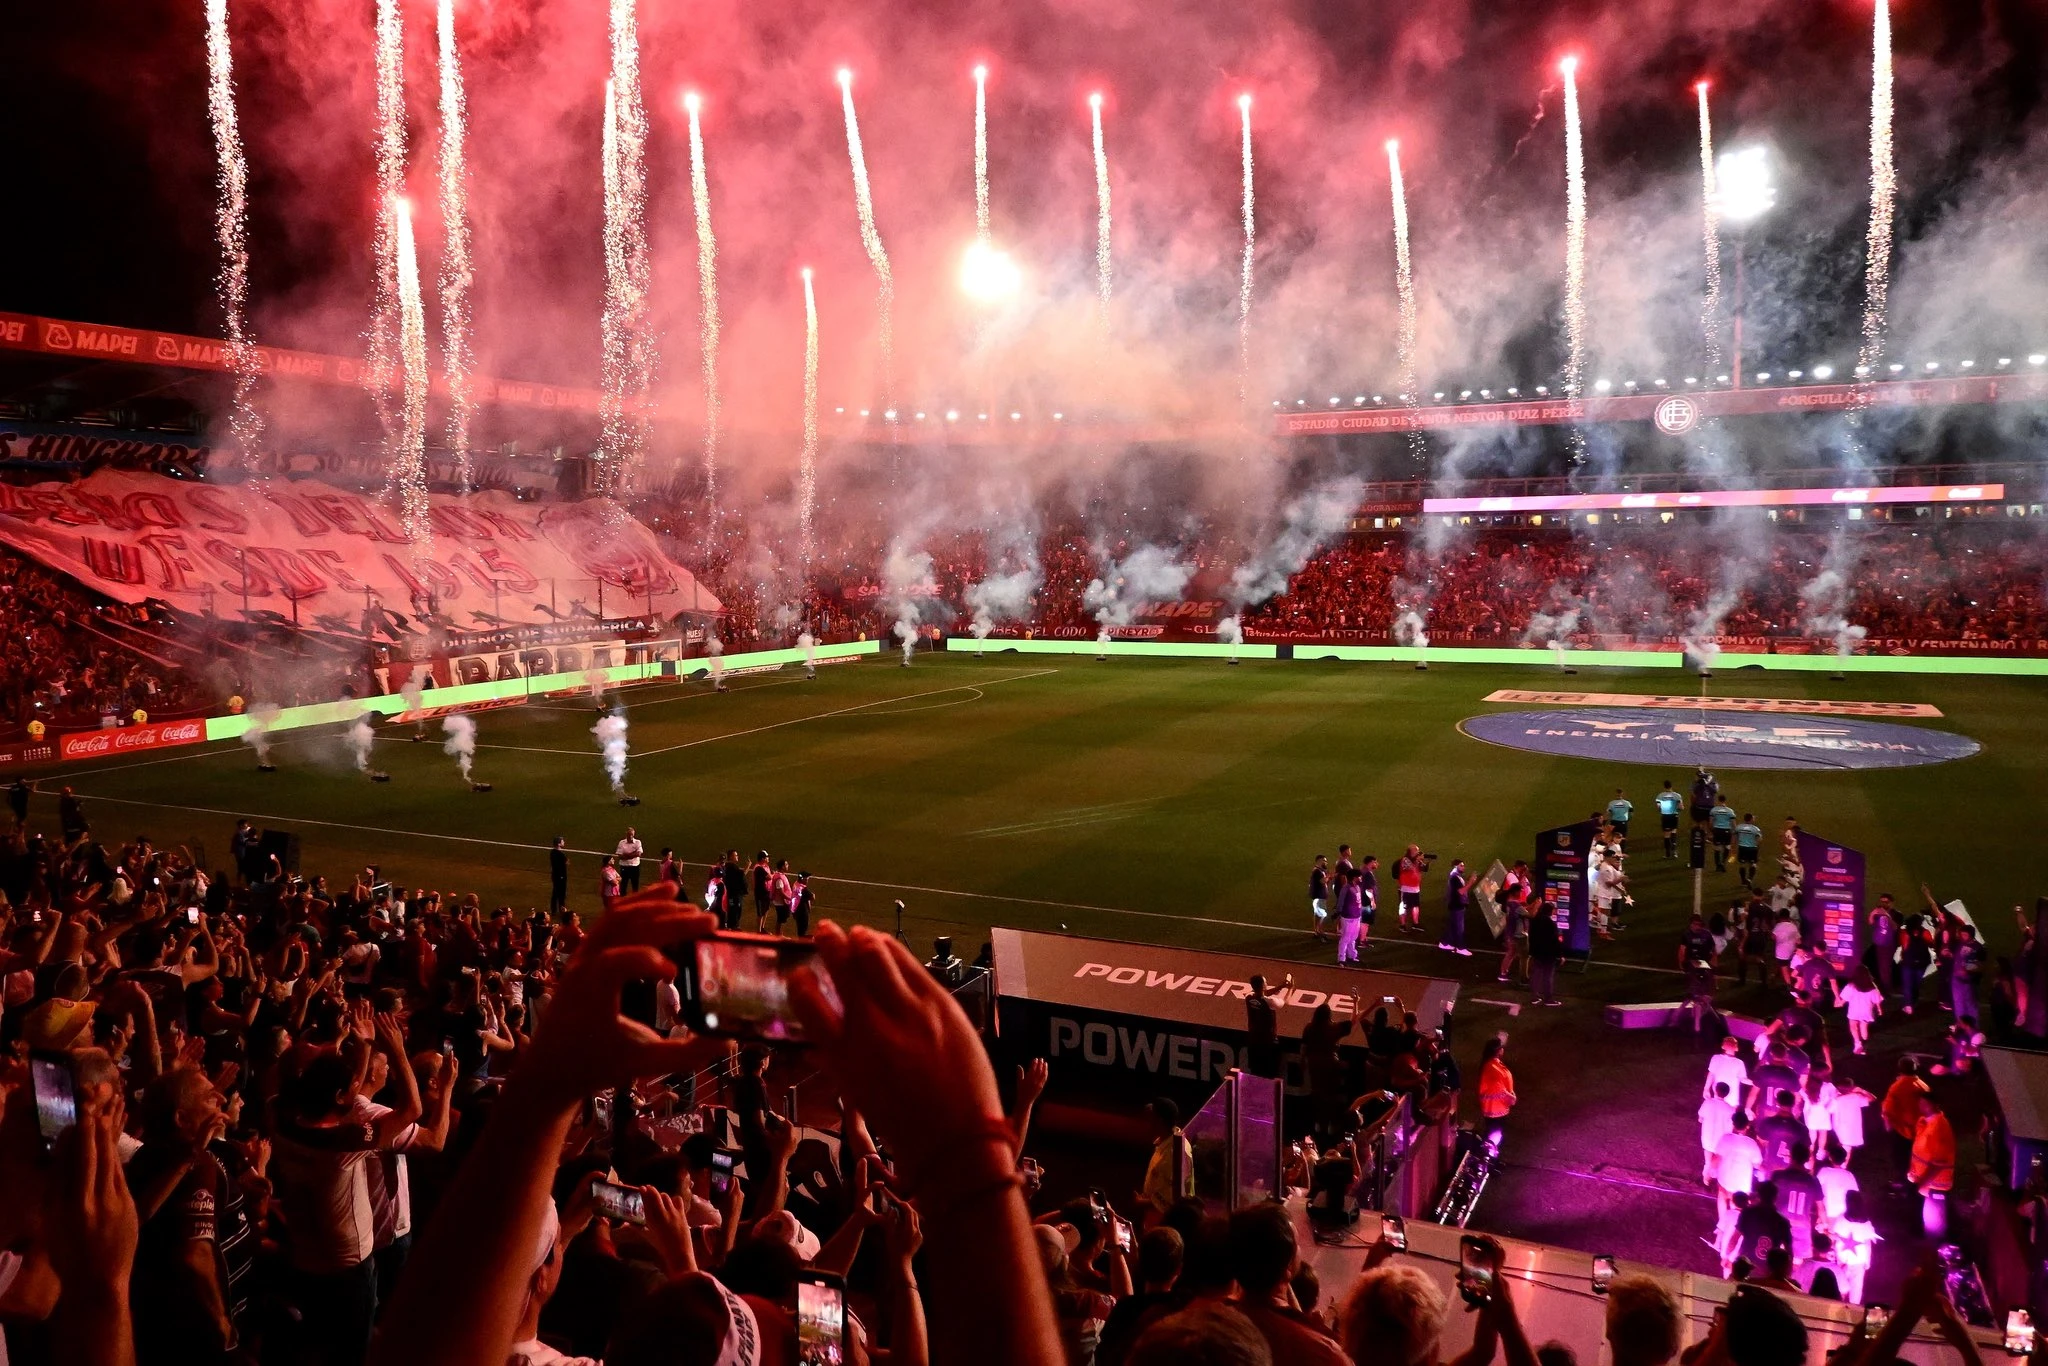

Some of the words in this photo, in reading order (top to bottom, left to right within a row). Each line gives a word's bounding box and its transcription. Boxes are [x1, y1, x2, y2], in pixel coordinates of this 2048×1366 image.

[77, 330, 138, 355] MAPEI
[182, 342, 240, 369] MAP
[276, 354, 324, 377] MAPEI
[1289, 418, 1339, 431] ESTADIO
[1342, 416, 1389, 429] CIUDAD
[1391, 415, 1408, 427] DE
[1054, 625, 1087, 638] CODO
[1525, 728, 1674, 742] ENERGÍA
[1567, 719, 1851, 737] YPF
[1776, 1140, 1791, 1164] 4
[1788, 1190, 1806, 1215] 11
[1755, 1235, 1773, 1260] 8
